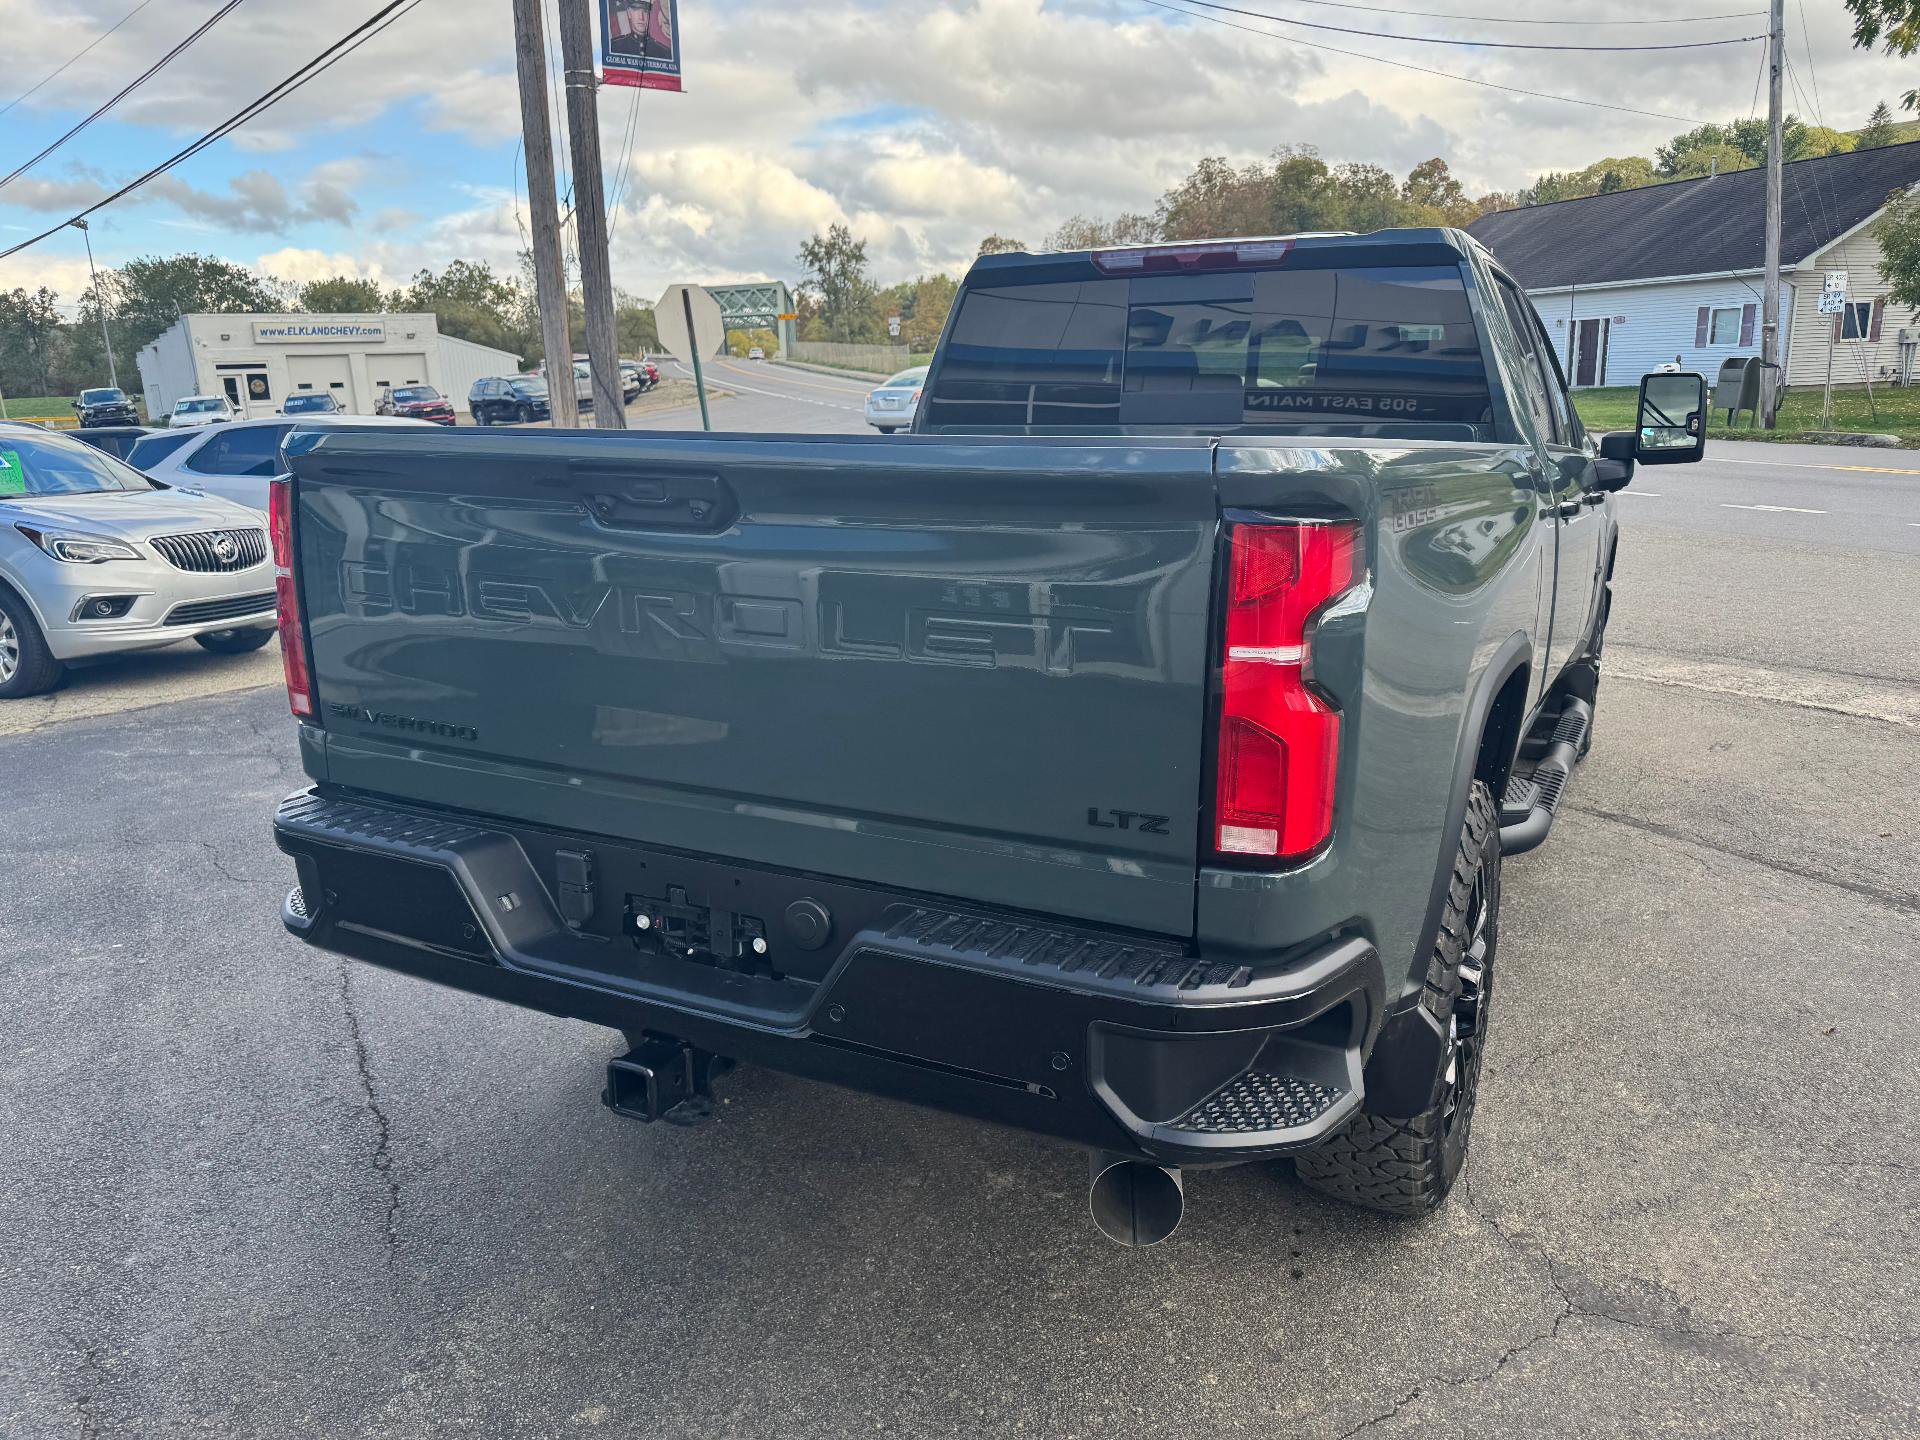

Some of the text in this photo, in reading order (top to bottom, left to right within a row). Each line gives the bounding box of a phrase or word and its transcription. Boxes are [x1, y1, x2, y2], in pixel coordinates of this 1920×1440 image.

[606, 56, 626, 65] GLOBAL
[260, 326, 381, 337] www.ELKLANDCHEVY.com
[1392, 509, 1436, 533] BOSS
[338, 559, 1113, 676] CHEVROLET
[328, 702, 479, 742] SILVERADO
[1087, 807, 1170, 835] LTZ
